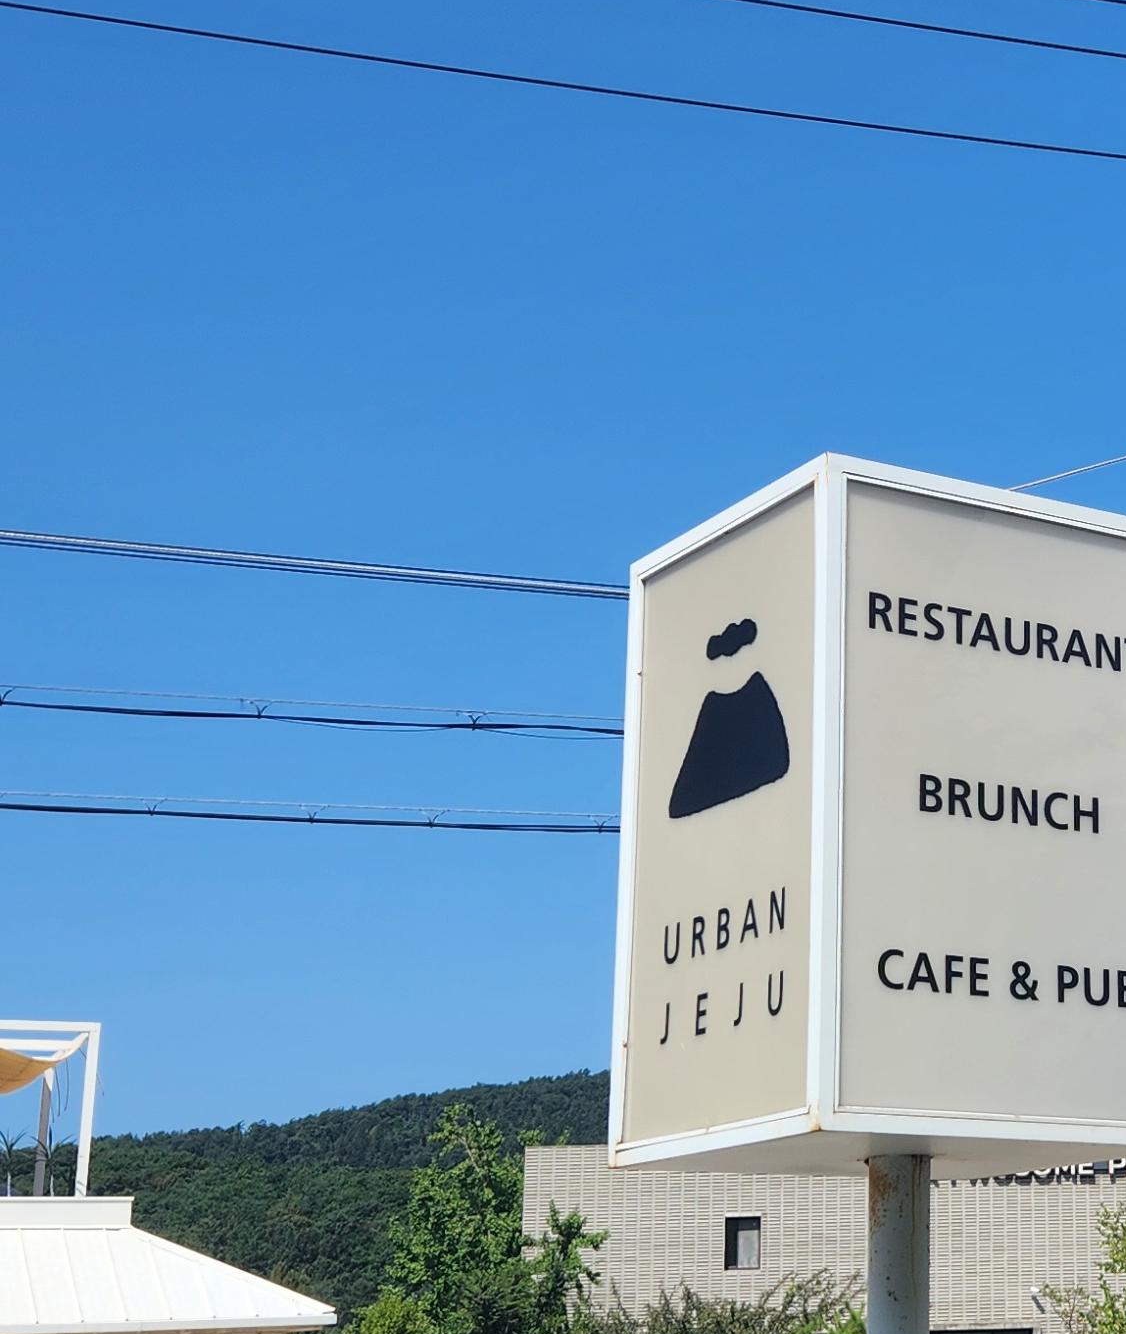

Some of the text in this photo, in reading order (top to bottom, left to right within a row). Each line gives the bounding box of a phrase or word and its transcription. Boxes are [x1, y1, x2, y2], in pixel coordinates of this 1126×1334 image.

[919, 773, 1100, 835] BRUNCH
[663, 885, 787, 966] URBAN
[659, 970, 785, 1046] JEJU
[877, 948, 990, 998] CAFE
[1009, 960, 1039, 1002] &
